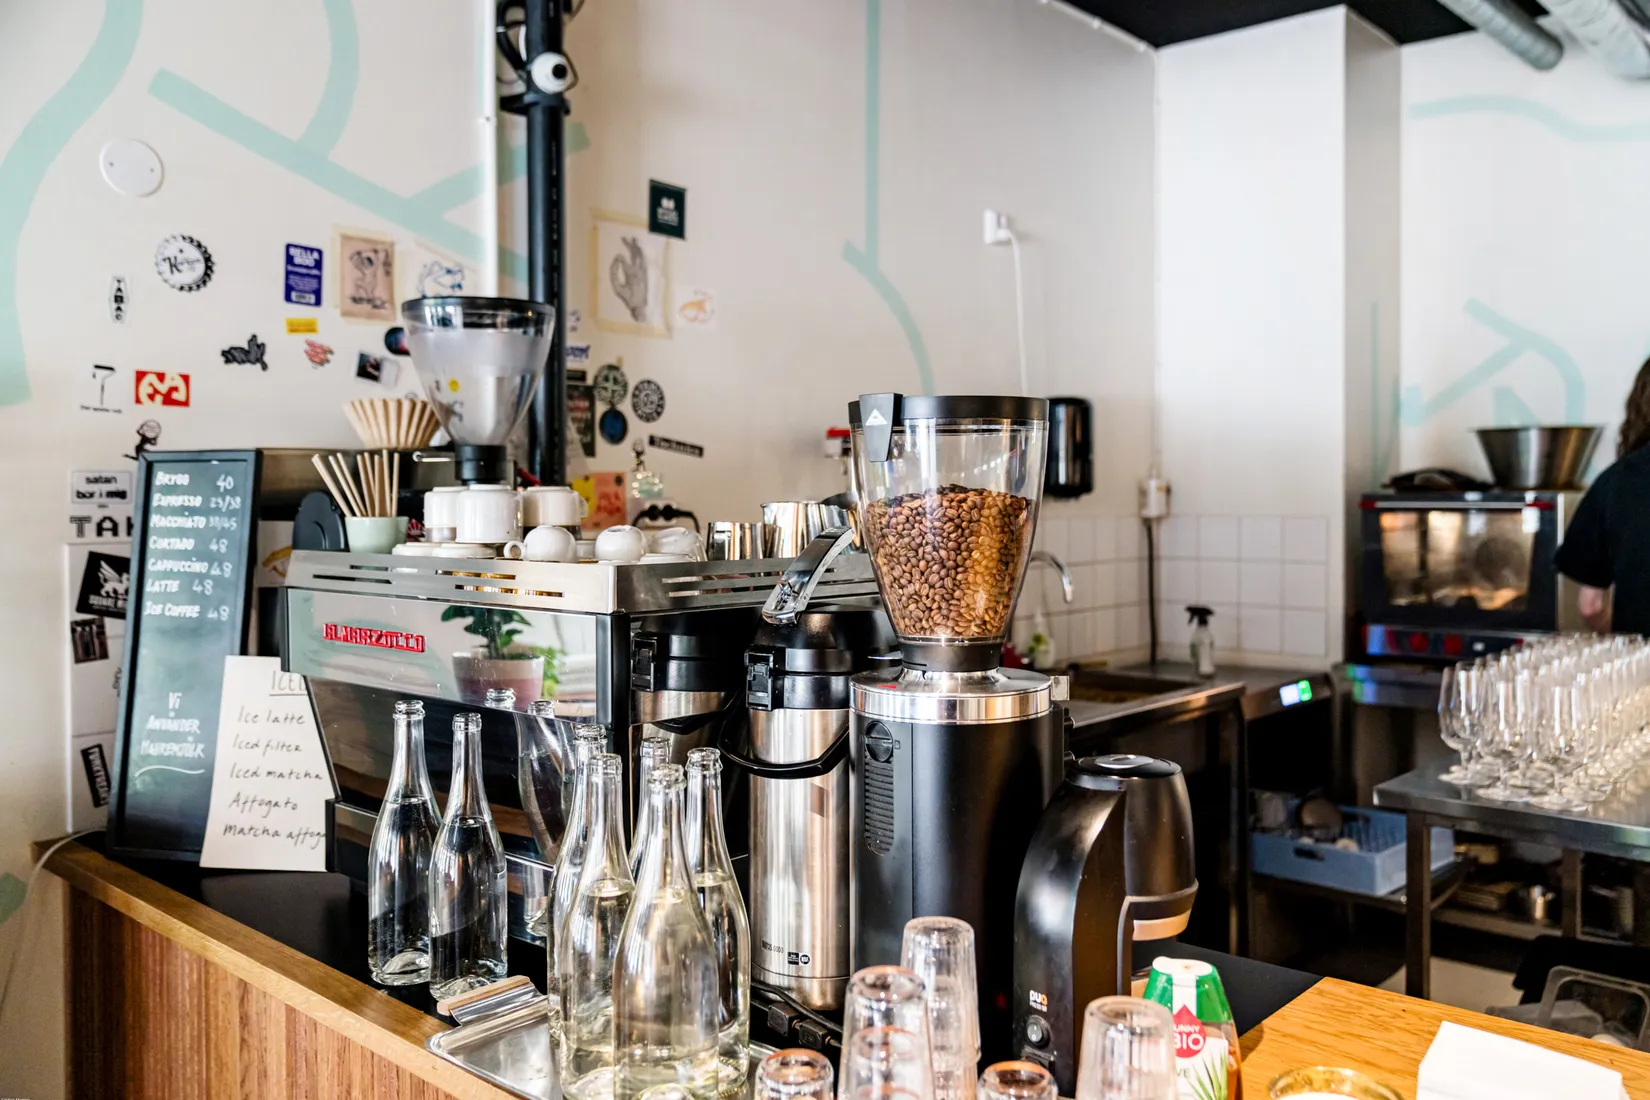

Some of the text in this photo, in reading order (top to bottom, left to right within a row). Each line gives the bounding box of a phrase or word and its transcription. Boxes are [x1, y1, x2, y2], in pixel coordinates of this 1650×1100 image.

[216, 473, 234, 493] 40
[209, 538, 228, 553] 48
[210, 561, 232, 578] 48
[146, 578, 214, 596] LATTE 48
[207, 605, 230, 621] 48
[238, 705, 306, 725] Ice latte
[232, 733, 260, 750] Iced
[230, 762, 324, 780] Iced matcha
[228, 791, 298, 819] Affogato
[1172, 1023, 1200, 1033] UNNY
